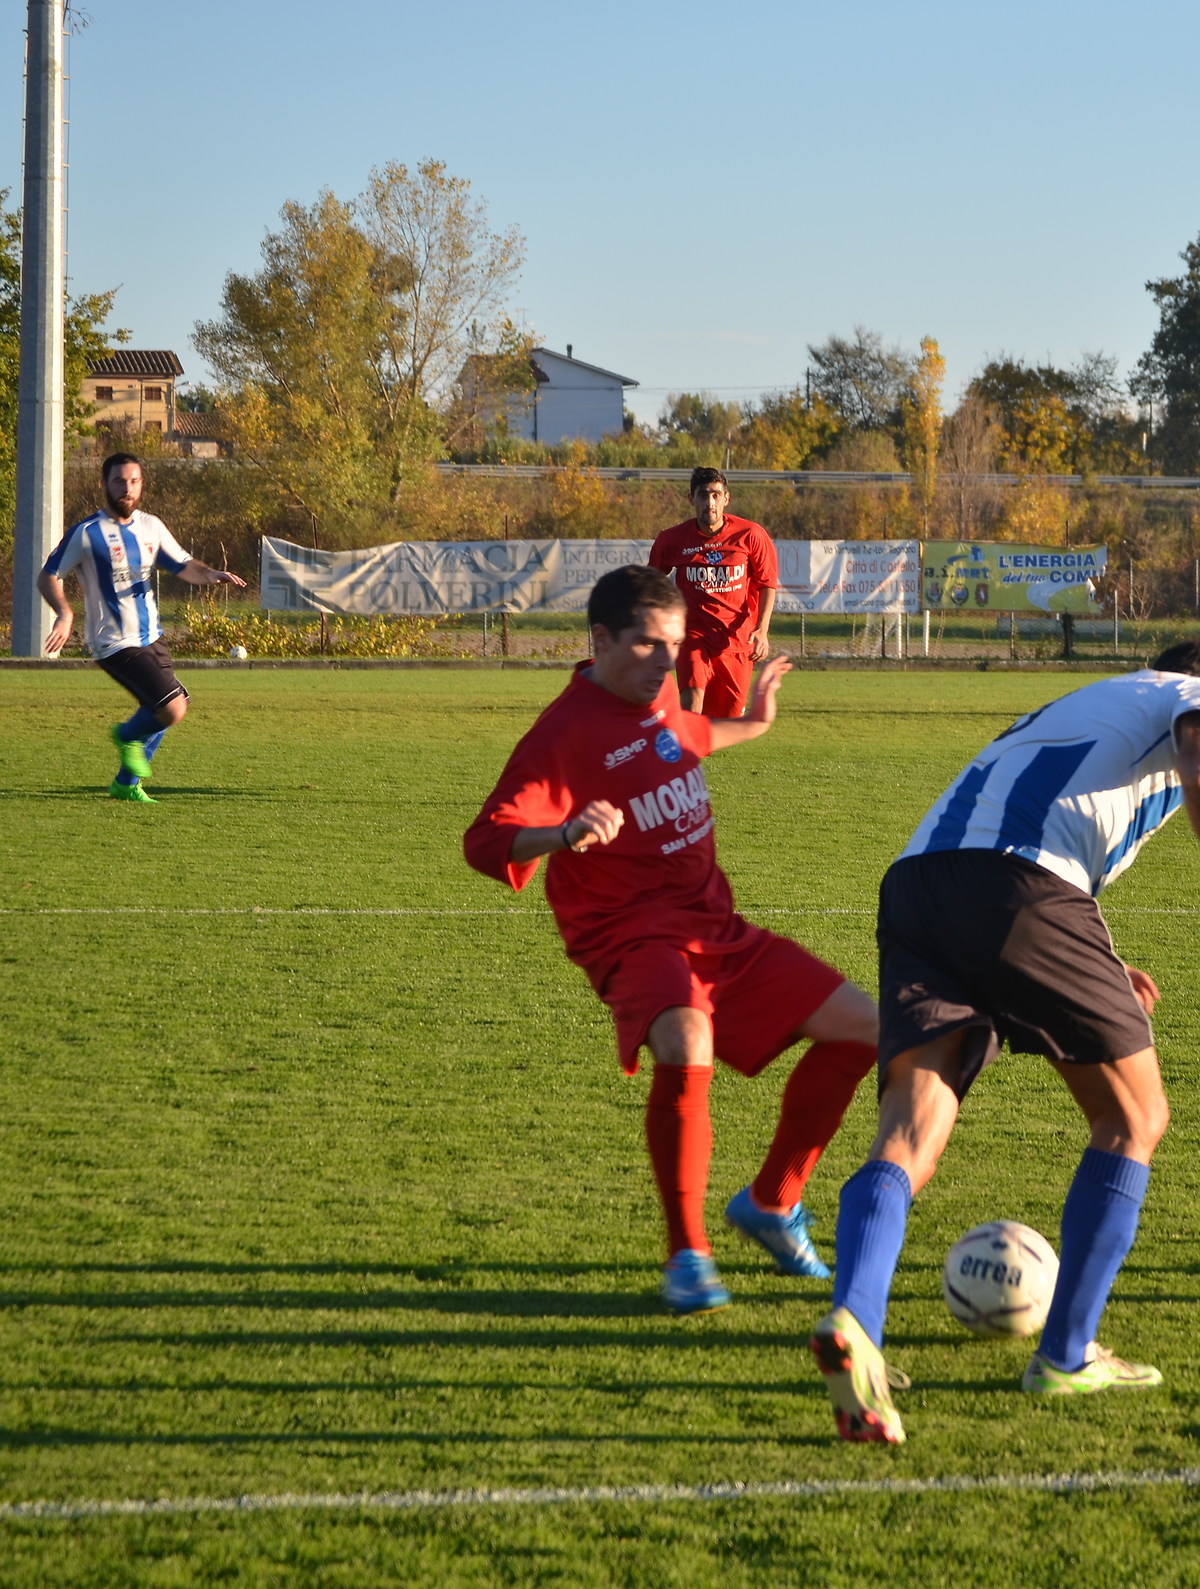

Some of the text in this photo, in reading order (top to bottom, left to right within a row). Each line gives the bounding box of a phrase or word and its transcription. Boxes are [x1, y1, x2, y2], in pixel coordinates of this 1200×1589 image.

[350, 544, 549, 574] FARMACIA
[869, 560, 878, 573] di
[998, 553, 1096, 568] L'ENERGIA
[564, 568, 598, 584] PER
[685, 563, 745, 582] MORALDI
[1002, 571, 1021, 583] del
[347, 581, 550, 611] POLVERINI
[661, 837, 687, 855] SAN
